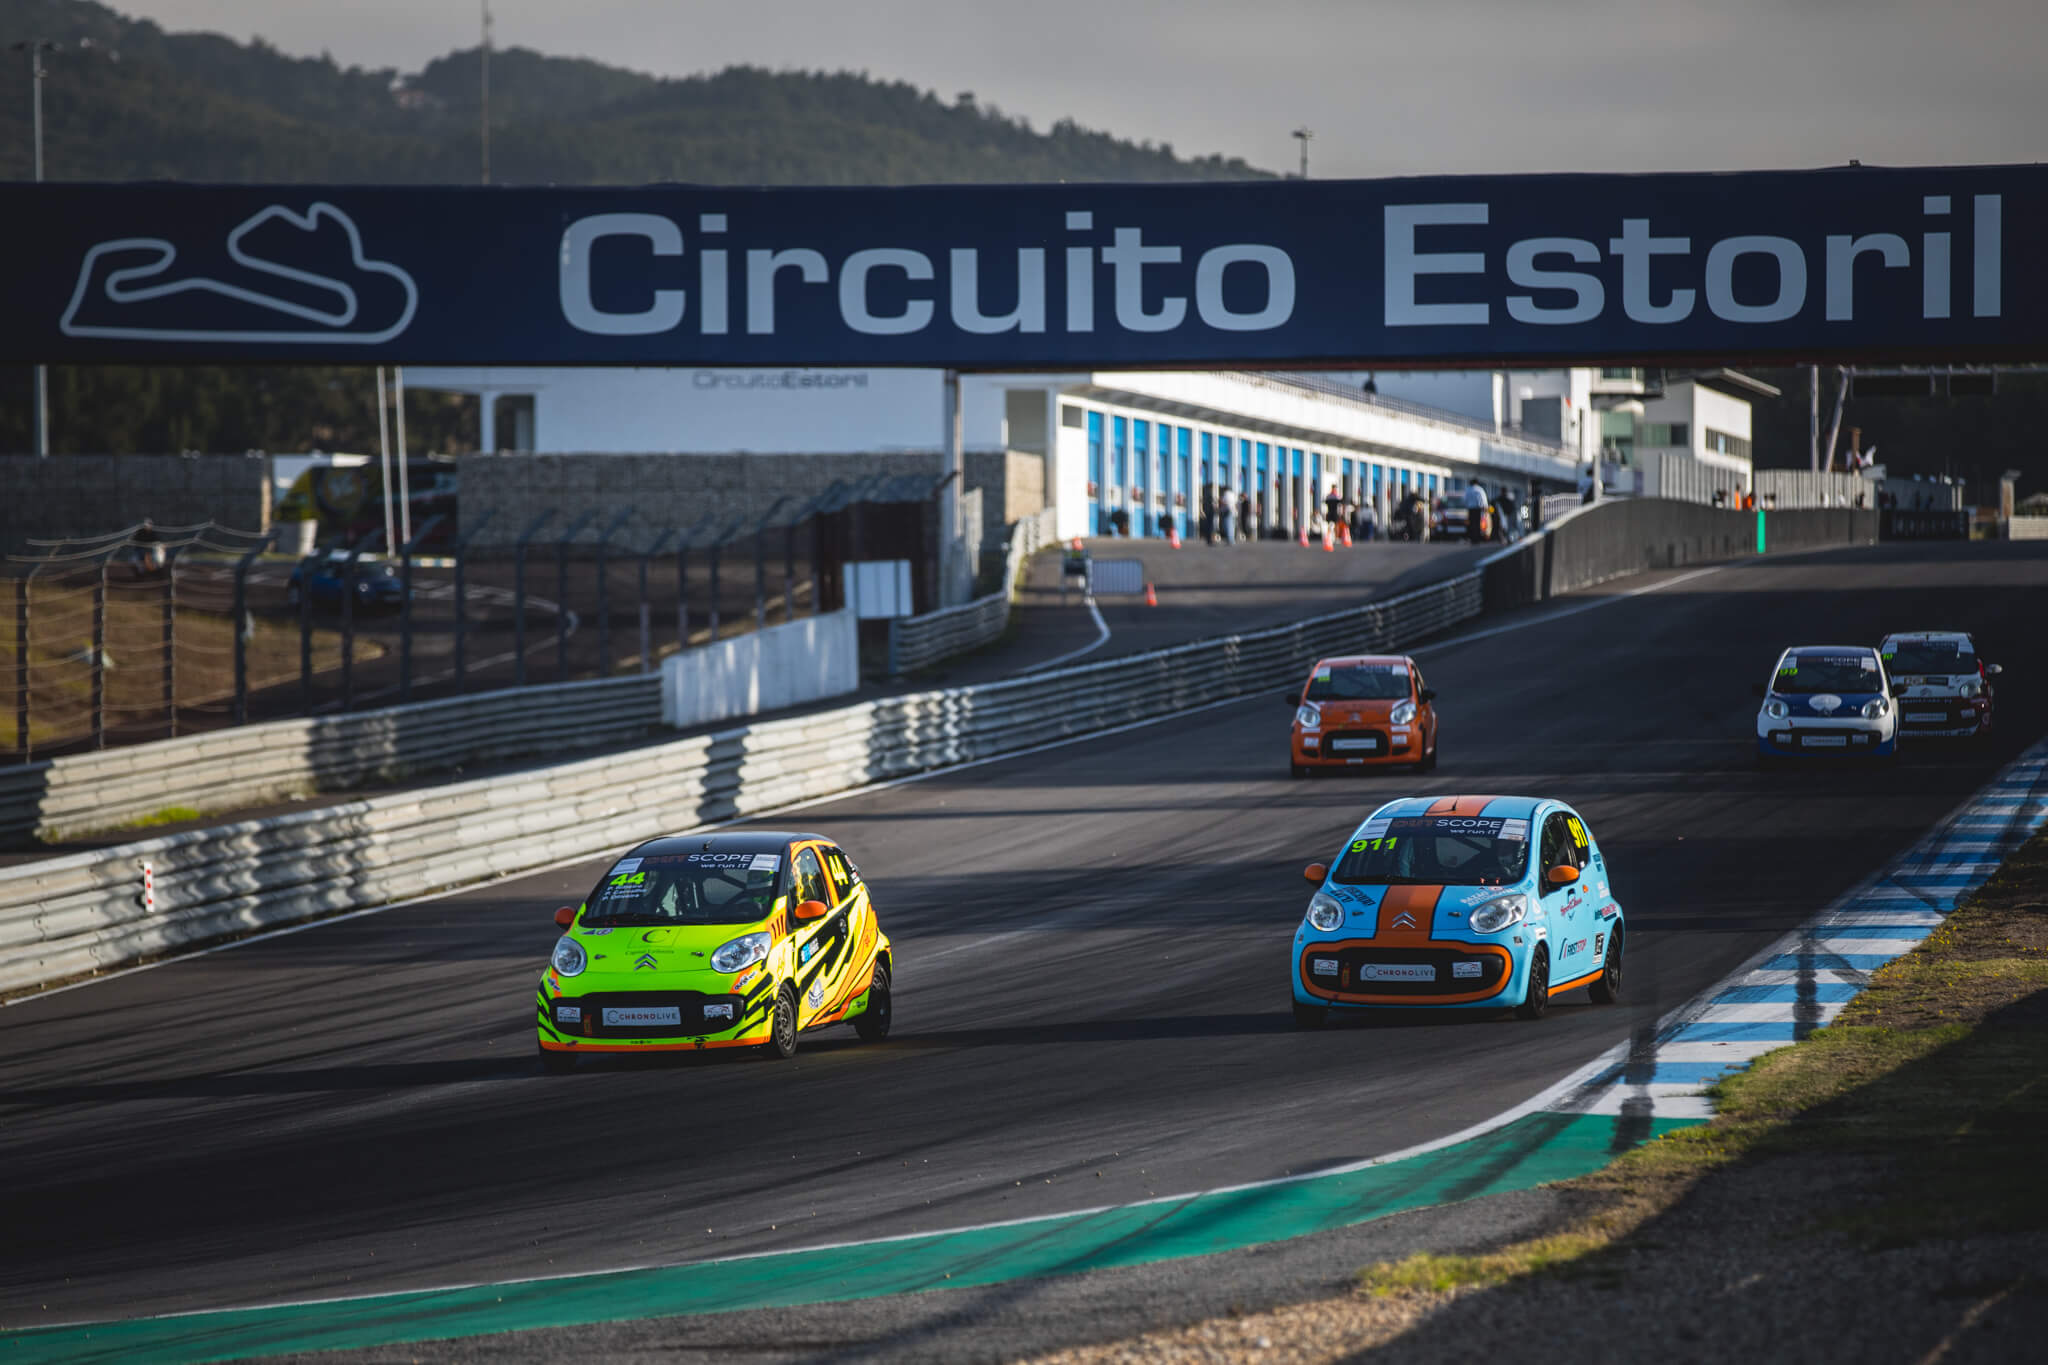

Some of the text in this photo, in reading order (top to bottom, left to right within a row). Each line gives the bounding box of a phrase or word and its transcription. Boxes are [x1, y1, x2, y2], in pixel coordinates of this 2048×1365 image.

[560, 194, 2001, 335] Circuito Estoril
[1351, 836, 1398, 853] 911
[1567, 817, 1589, 849] 911
[609, 872, 646, 886] 44
[828, 854, 849, 886] 44
[619, 1012, 678, 1021] CHRONOLIVE
